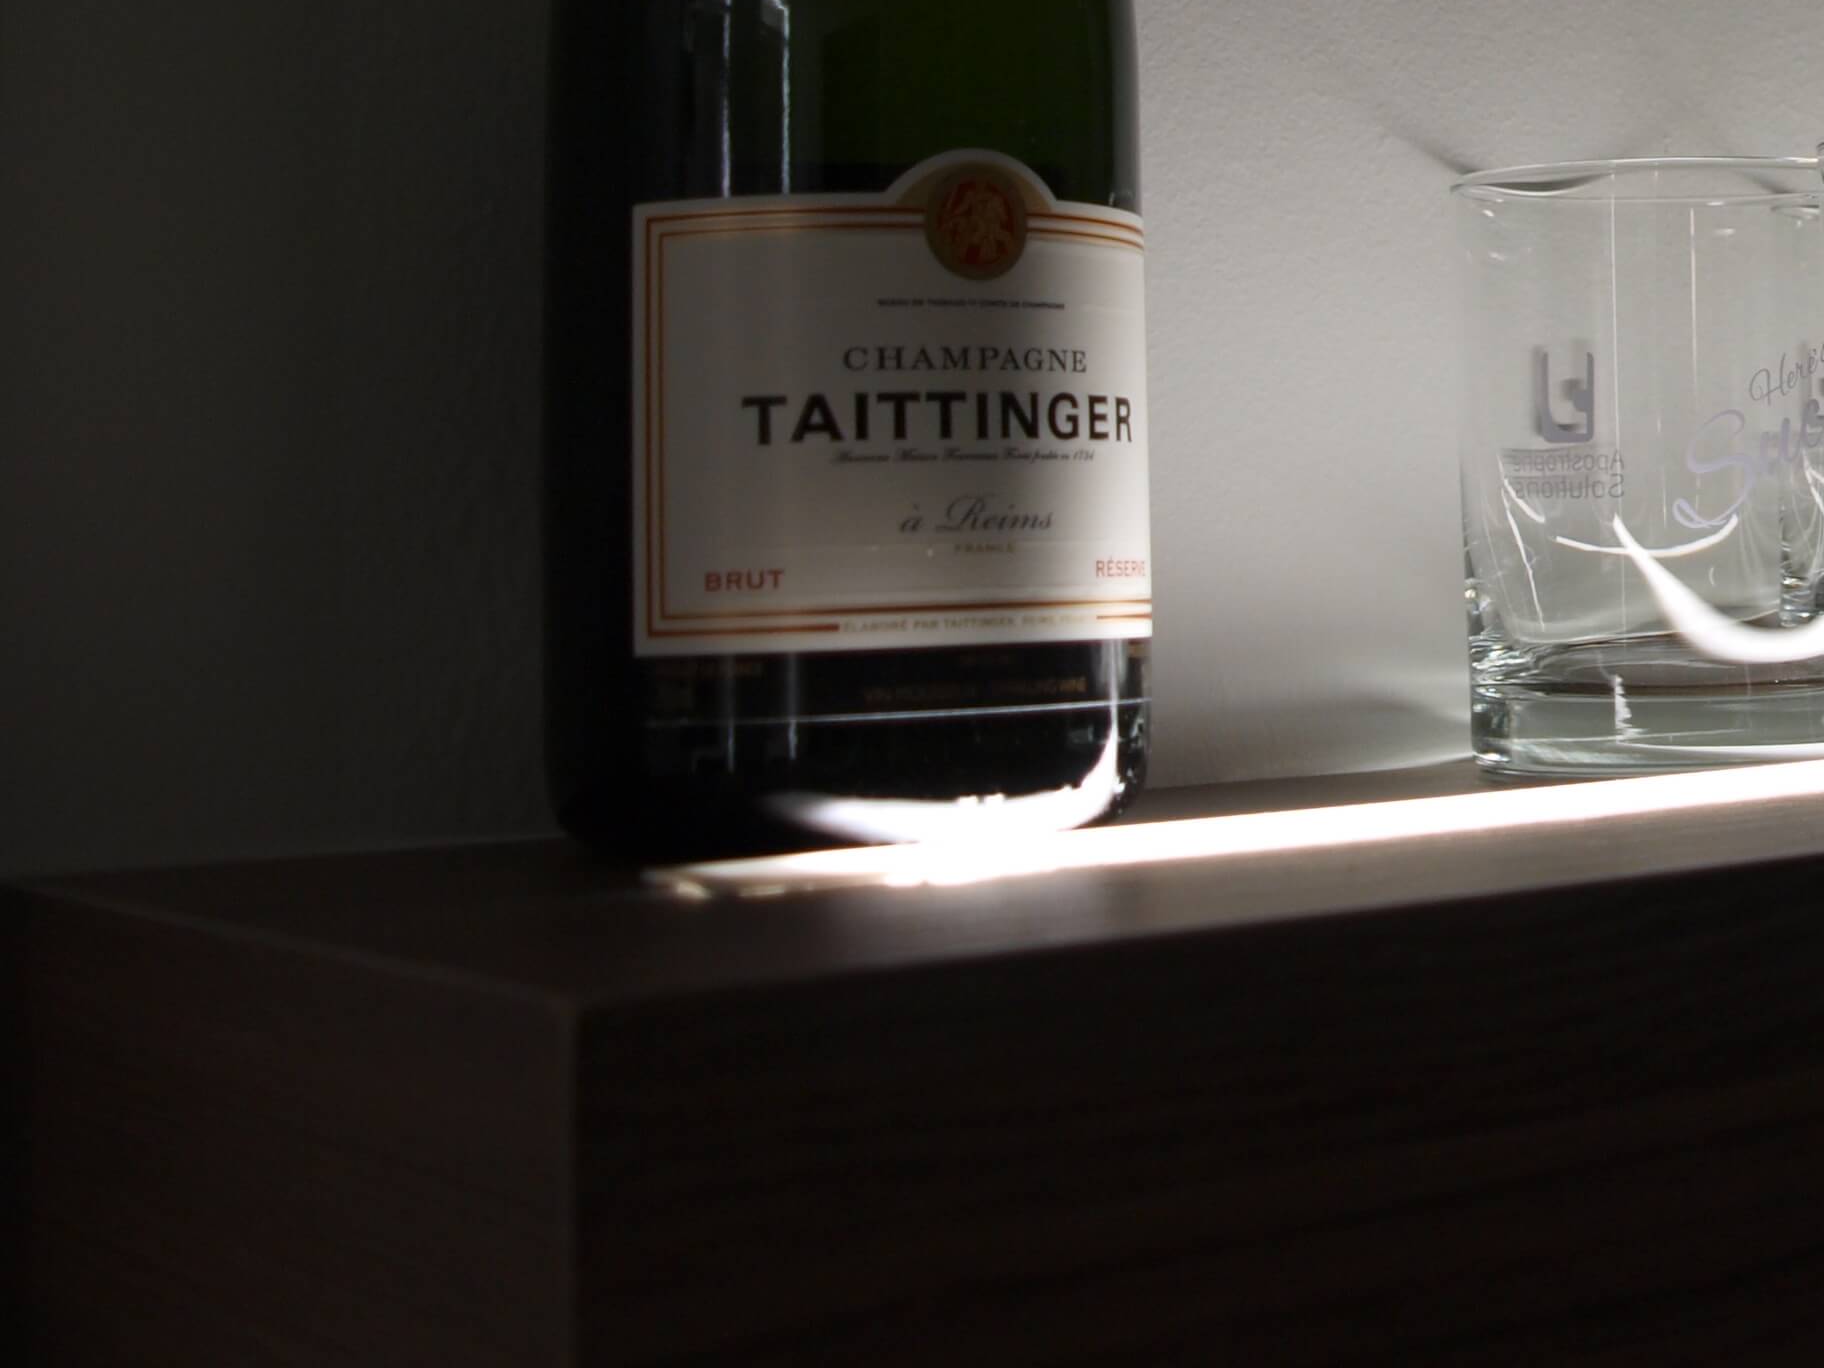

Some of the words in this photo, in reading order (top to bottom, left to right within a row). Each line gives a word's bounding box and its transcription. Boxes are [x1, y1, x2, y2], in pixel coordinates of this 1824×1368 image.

[843, 345, 1088, 374] CHAMPAGNE
[741, 390, 1133, 447] TAITTINGER
[935, 494, 1055, 533] Reims
[704, 568, 785, 592] BRUT
